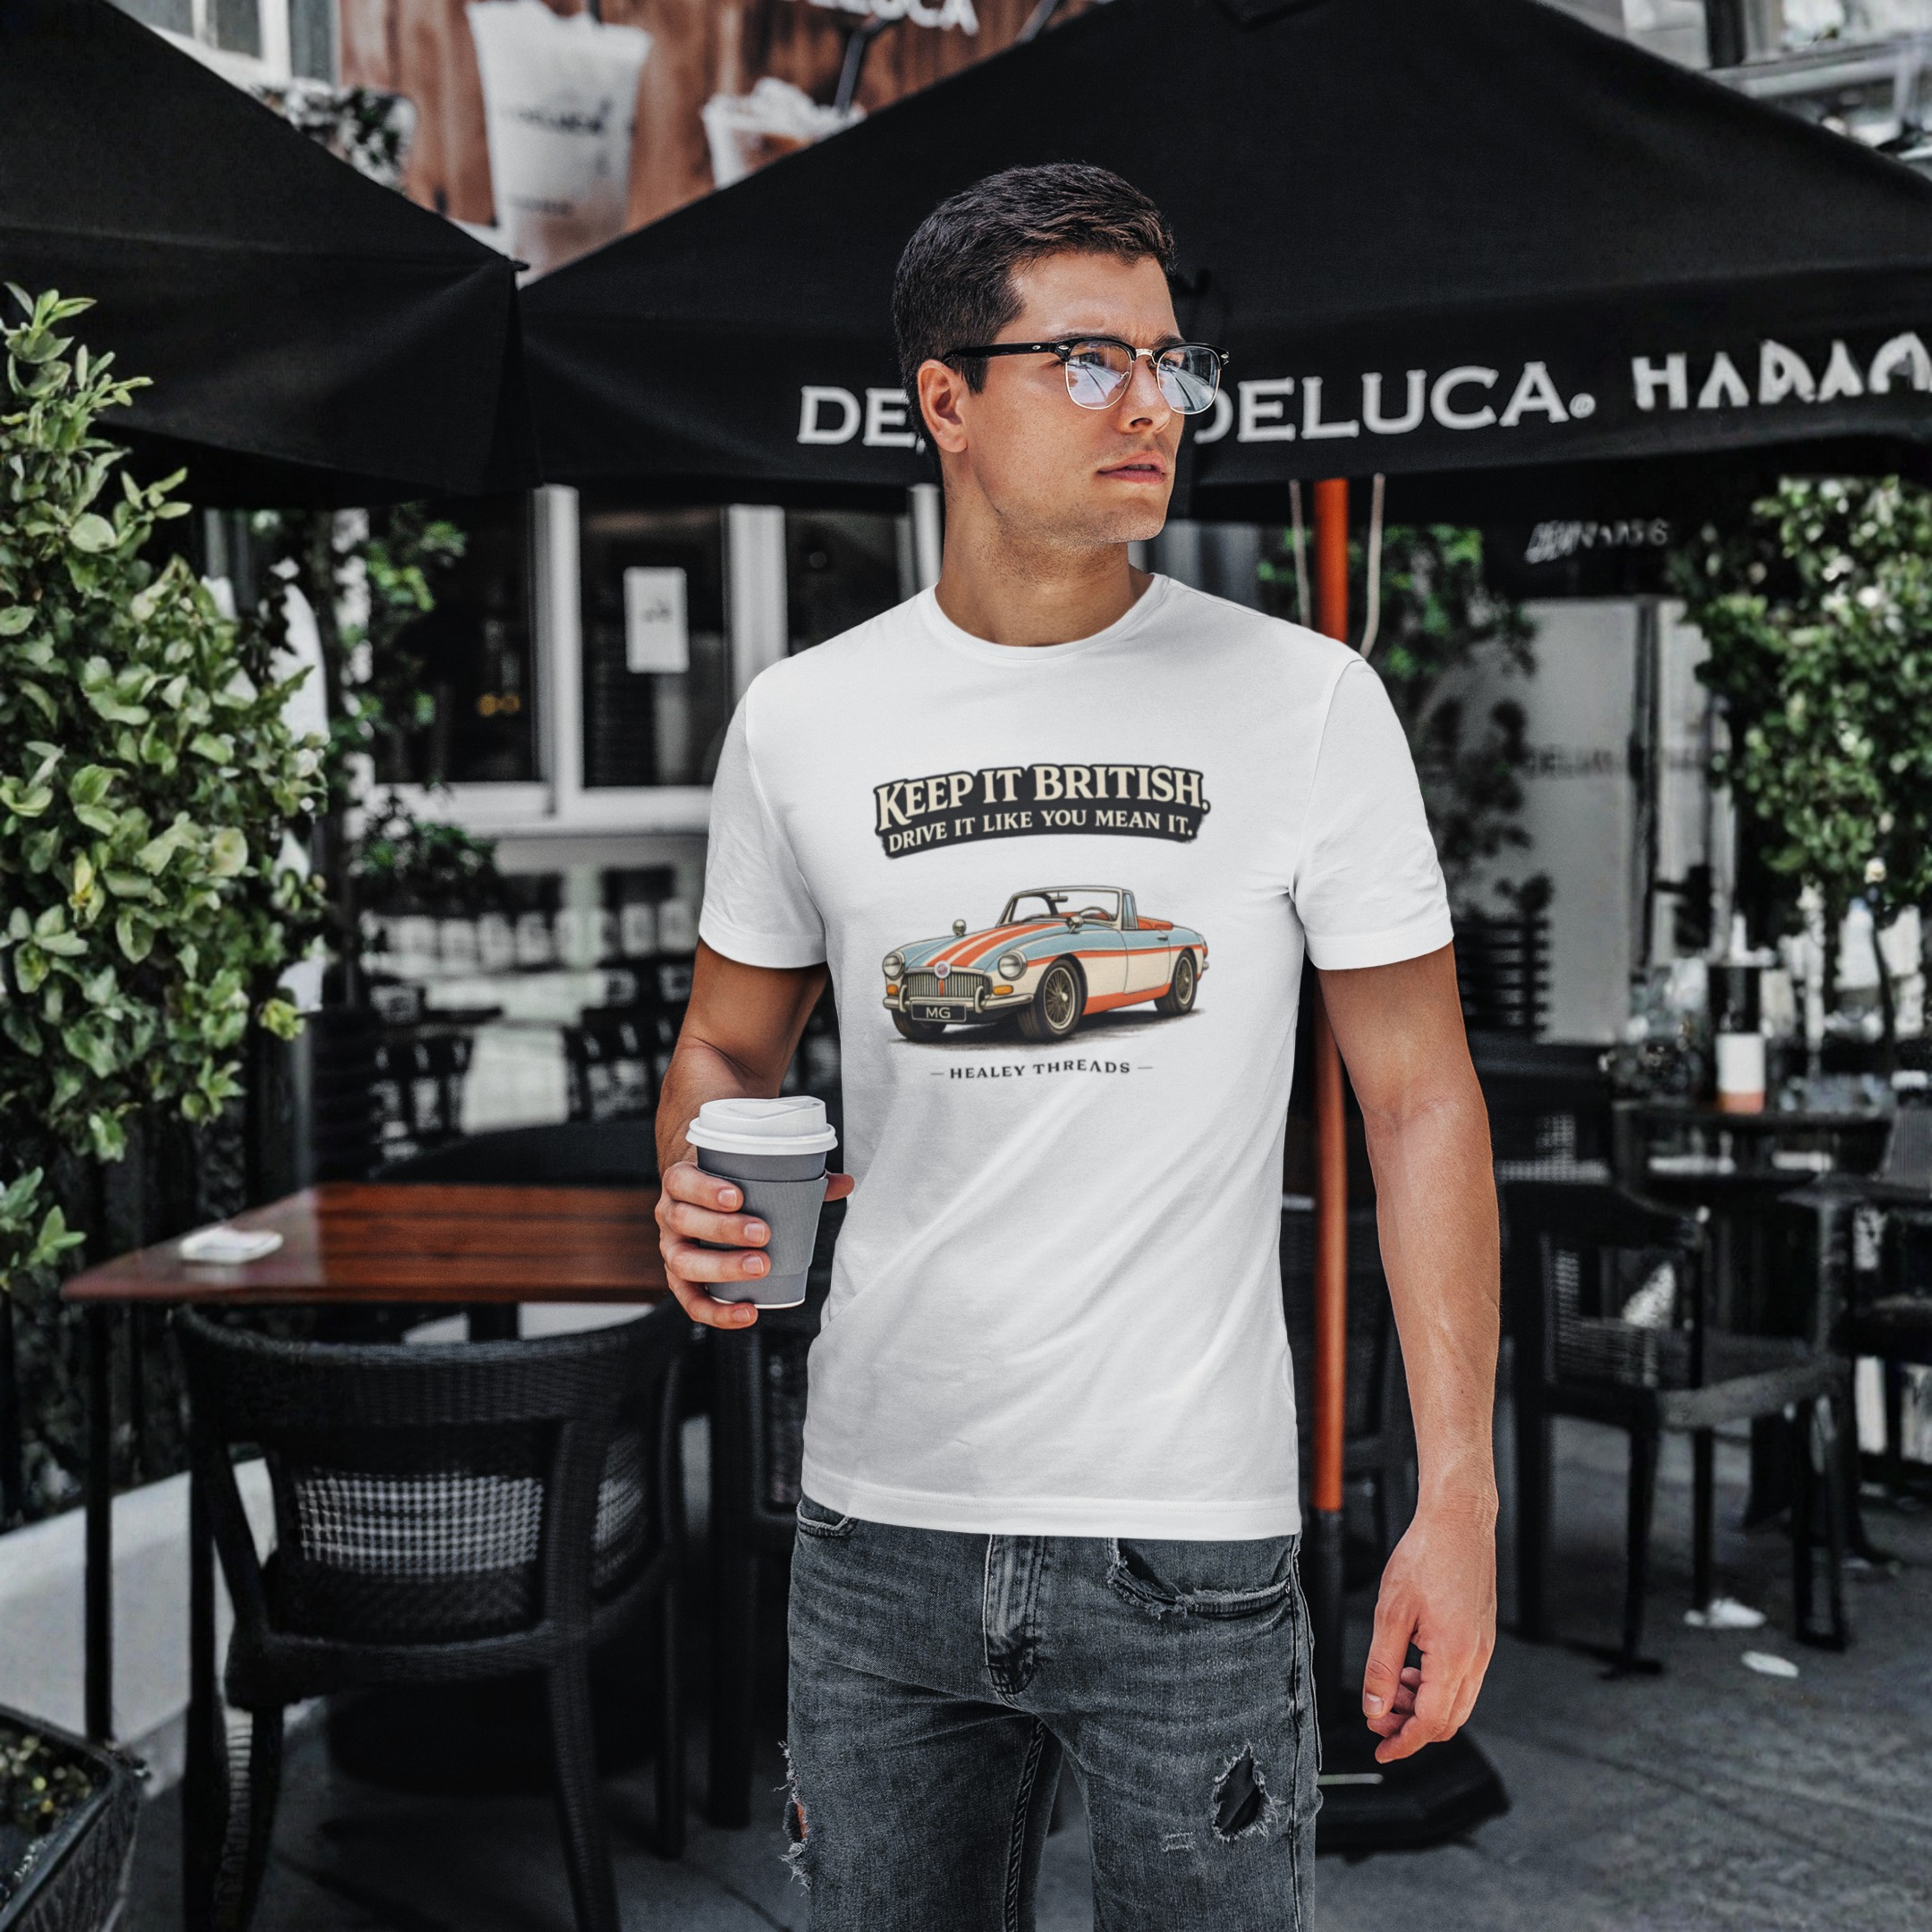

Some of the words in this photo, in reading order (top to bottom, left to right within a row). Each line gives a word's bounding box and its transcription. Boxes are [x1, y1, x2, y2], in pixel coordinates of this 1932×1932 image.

[796, 385, 926, 454] DE
[877, 773, 974, 831] KEEP
[982, 768, 1022, 803] IT
[1032, 766, 1209, 811] BRITISH.
[889, 821, 948, 852] DRIVE
[954, 817, 976, 837] IT
[983, 811, 1033, 832] LIKE
[1040, 809, 1087, 827] YOU
[1095, 810, 1160, 830] MEAN
[1168, 814, 1193, 836] IT.
[926, 1007, 950, 1019] MG
[950, 1065, 1025, 1079] HEALEY
[1032, 1059, 1131, 1074] THREADS
